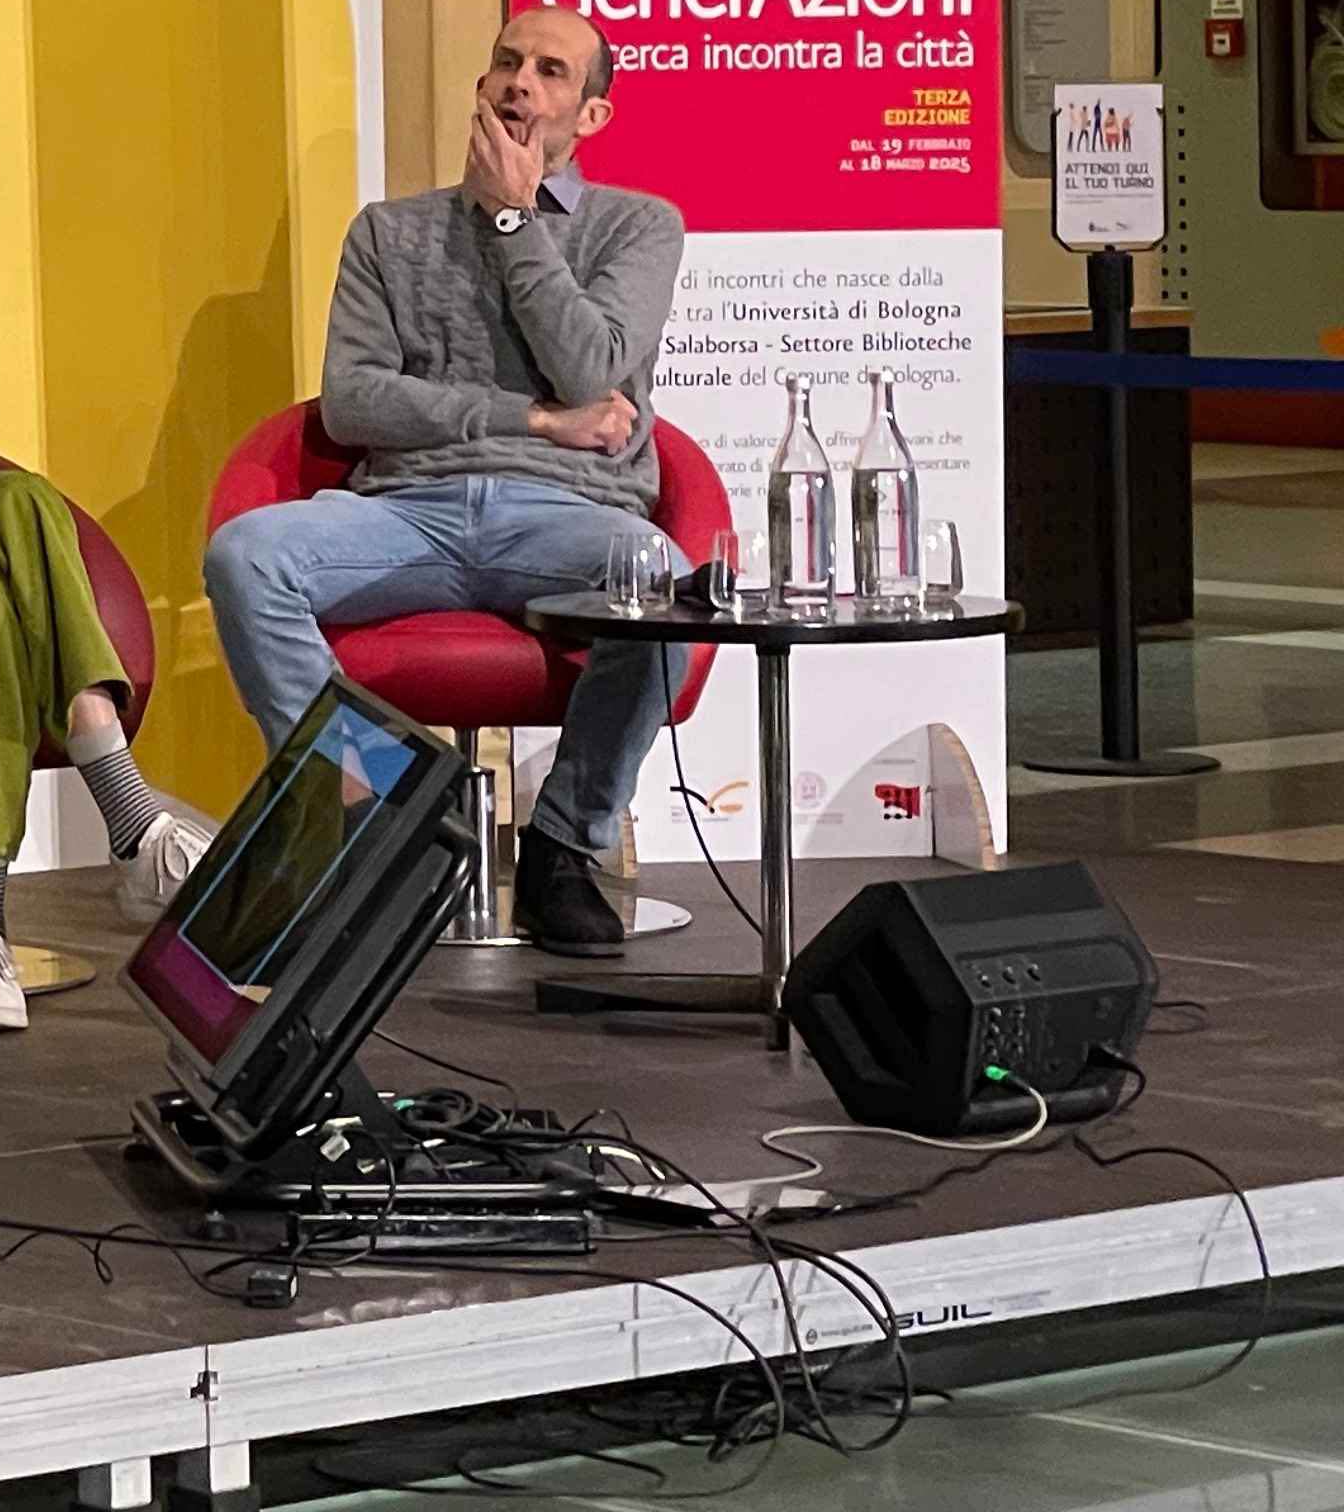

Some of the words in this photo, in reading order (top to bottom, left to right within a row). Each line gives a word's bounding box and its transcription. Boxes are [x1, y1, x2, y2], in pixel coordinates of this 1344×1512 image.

[609, 44, 688, 71] erca
[704, 34, 842, 71] incontra
[857, 30, 882, 68] la
[896, 29, 974, 69] città
[912, 88, 972, 106] TERZA
[884, 108, 971, 126] EDIZIONE
[850, 138, 874, 152] DAL
[881, 137, 902, 154] 19
[840, 158, 855, 171] AL
[862, 154, 881, 171] 18
[929, 156, 971, 173] 2025
[1065, 162, 1120, 175] ATTENDI
[1126, 162, 1149, 176] QUI
[1065, 177, 1080, 189] IL
[1084, 177, 1109, 189] TUO
[1113, 177, 1154, 189] TURNO
[681, 269, 698, 289] di
[708, 268, 784, 289] incontri
[793, 268, 827, 288] che
[836, 271, 891, 288] nasce
[898, 266, 943, 287] dalla
[687, 305, 713, 322] tra
[848, 300, 867, 320] di
[878, 299, 961, 326] Bologna
[665, 334, 759, 355] Salaborsa
[780, 334, 854, 354] Settore
[863, 331, 972, 352] Biblioteche
[652, 367, 732, 388] ulturale
[740, 366, 766, 386] del
